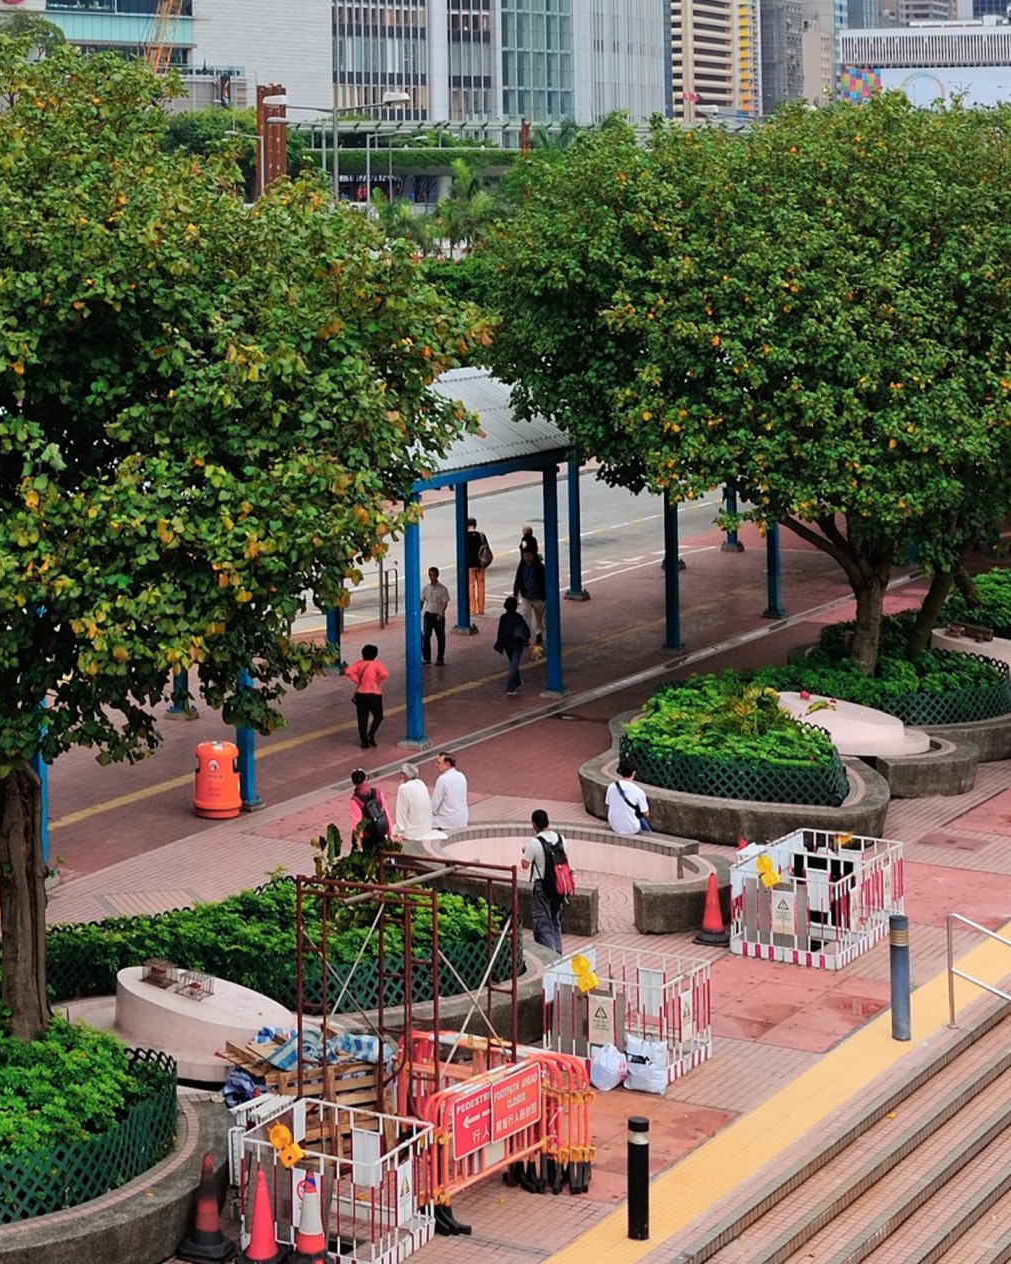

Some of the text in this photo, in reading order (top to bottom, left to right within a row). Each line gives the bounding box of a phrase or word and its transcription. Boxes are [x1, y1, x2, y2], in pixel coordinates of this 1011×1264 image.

[521, 1073, 538, 1087] AHEAD
[456, 1091, 491, 1115] PEDESTRI
[507, 1092, 526, 1109] CLOSED
